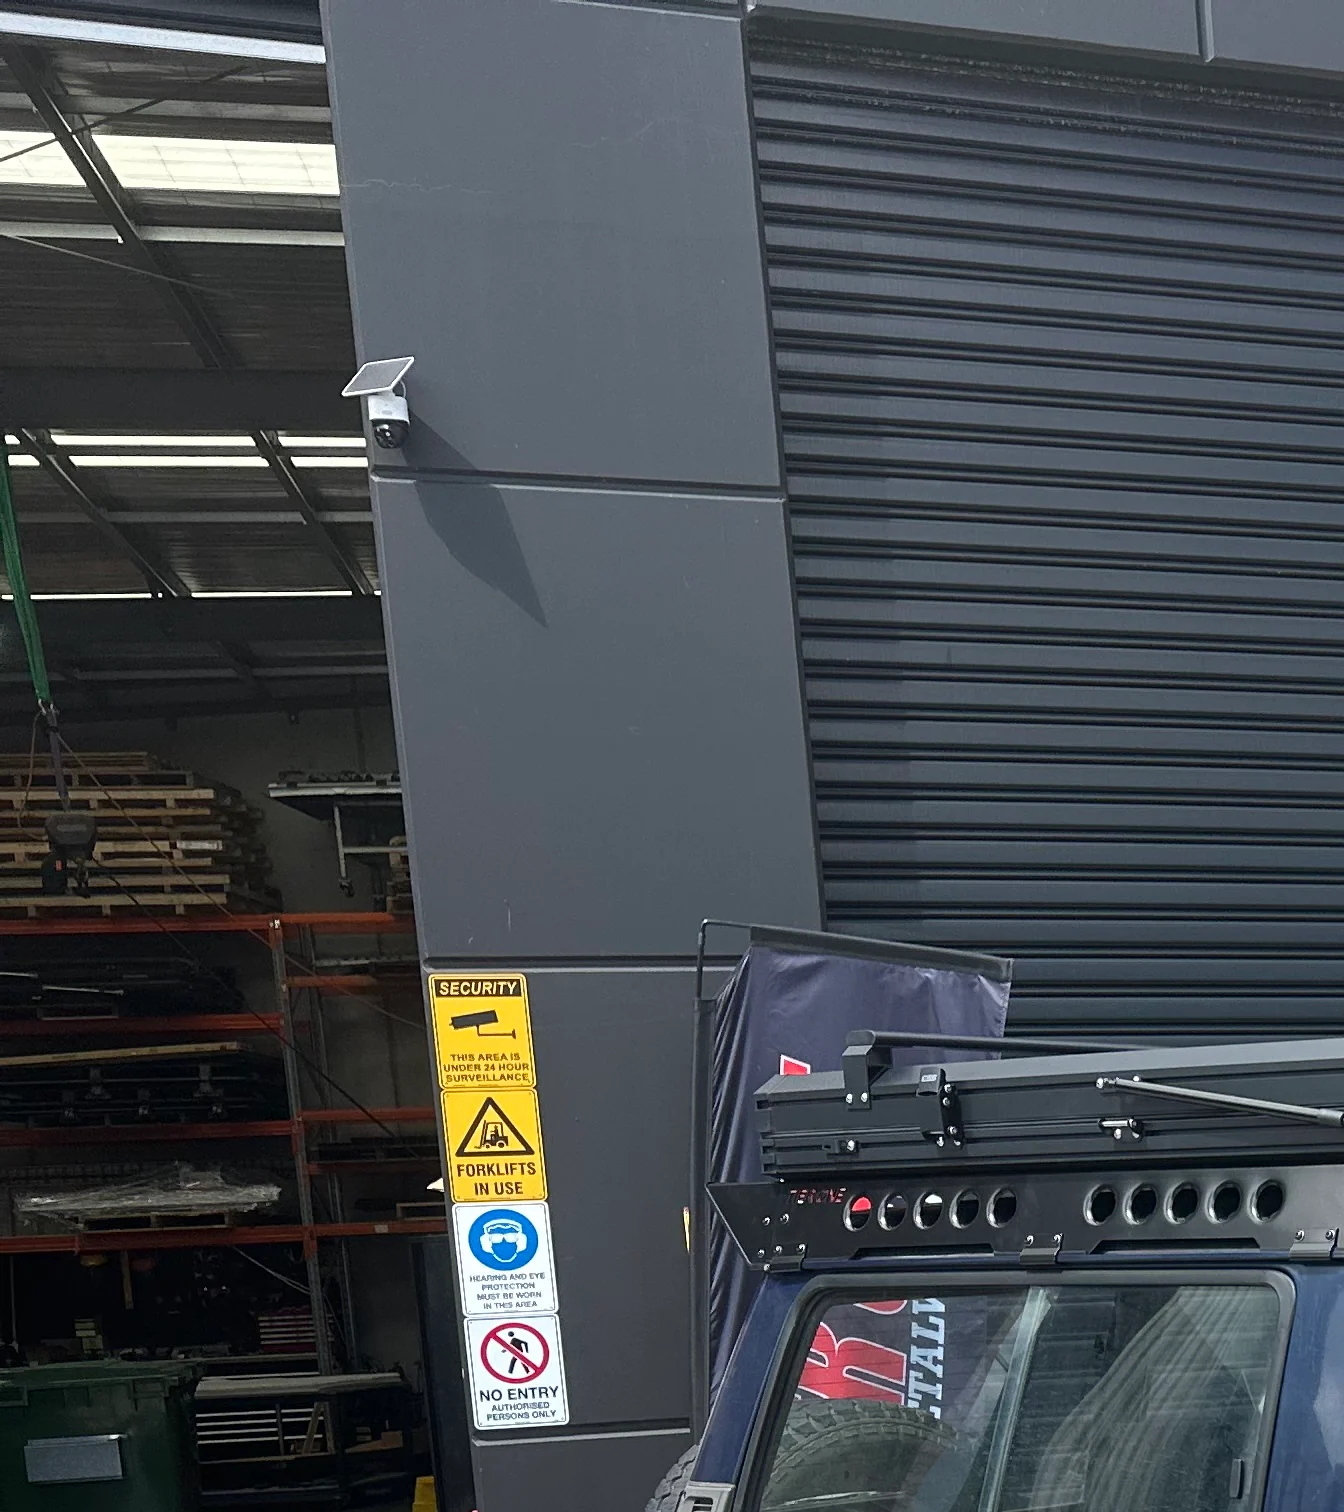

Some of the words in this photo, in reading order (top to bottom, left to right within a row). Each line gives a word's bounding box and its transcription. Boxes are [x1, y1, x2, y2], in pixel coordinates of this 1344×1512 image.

[439, 981, 518, 996] SECURITY
[450, 1053, 475, 1062] THIS
[478, 1053, 508, 1061] AREA
[510, 1052, 521, 1061] IS
[443, 1063, 481, 1072] UNDER
[484, 1063, 496, 1071] 24
[499, 1063, 529, 1071] HOUR
[446, 1073, 529, 1082] SURVEILLANCE
[456, 1162, 536, 1178] FORKLIFTS
[474, 1182, 489, 1196] IN
[494, 1181, 524, 1195] USE
[469, 1274, 508, 1282] HEARING
[510, 1273, 527, 1281] AND
[529, 1272, 546, 1280] EYE
[481, 1282, 536, 1291] PROTECTION
[515, 1291, 542, 1299] WORN
[483, 1302, 492, 1310] IN
[515, 1300, 538, 1308] AREA
[480, 1389, 503, 1402] NO
[507, 1385, 559, 1401] ENTRY
[491, 1401, 550, 1412] AUTHORISED
[486, 1411, 530, 1421] PERSONS
[531, 1410, 557, 1419] ONLY
